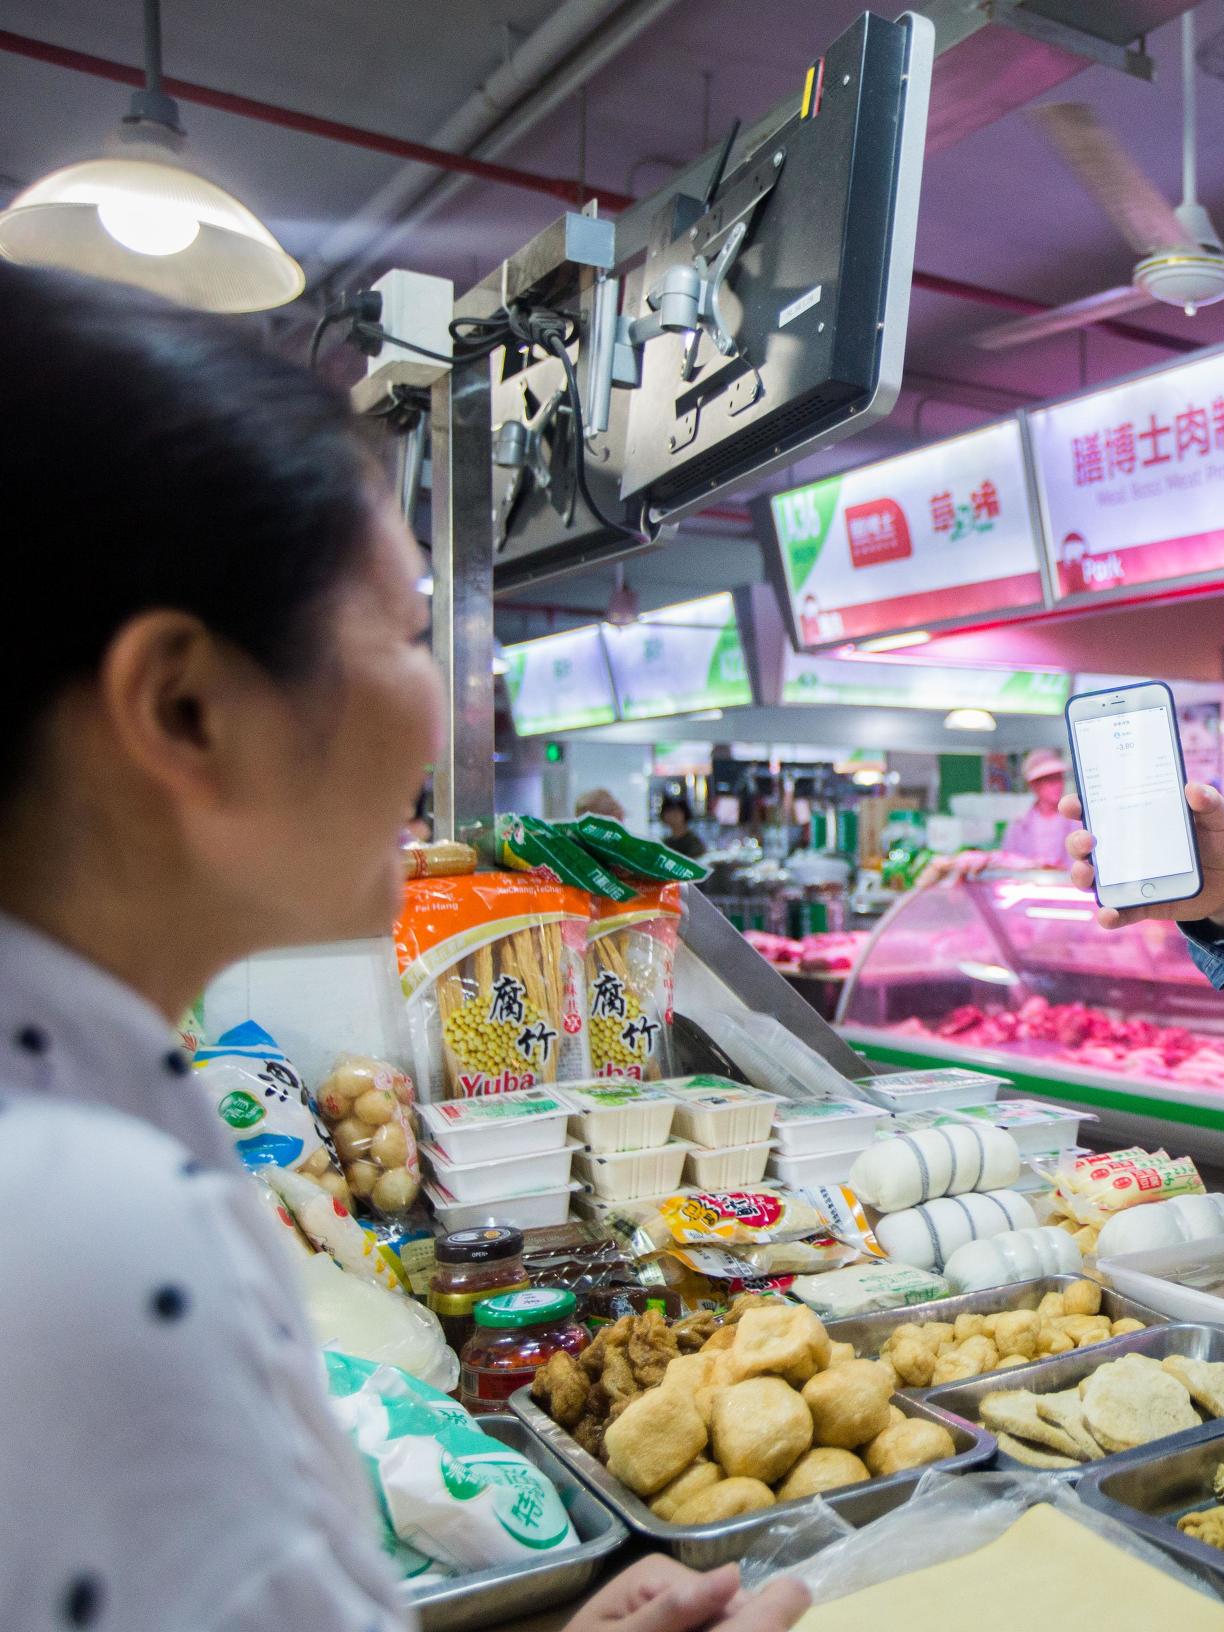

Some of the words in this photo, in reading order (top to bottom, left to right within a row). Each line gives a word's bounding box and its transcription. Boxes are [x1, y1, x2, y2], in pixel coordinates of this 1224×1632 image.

[490, 975, 557, 1062] 腐竹
[591, 974, 659, 1053] 腐竹
[460, 1070, 536, 1098] Yuba
